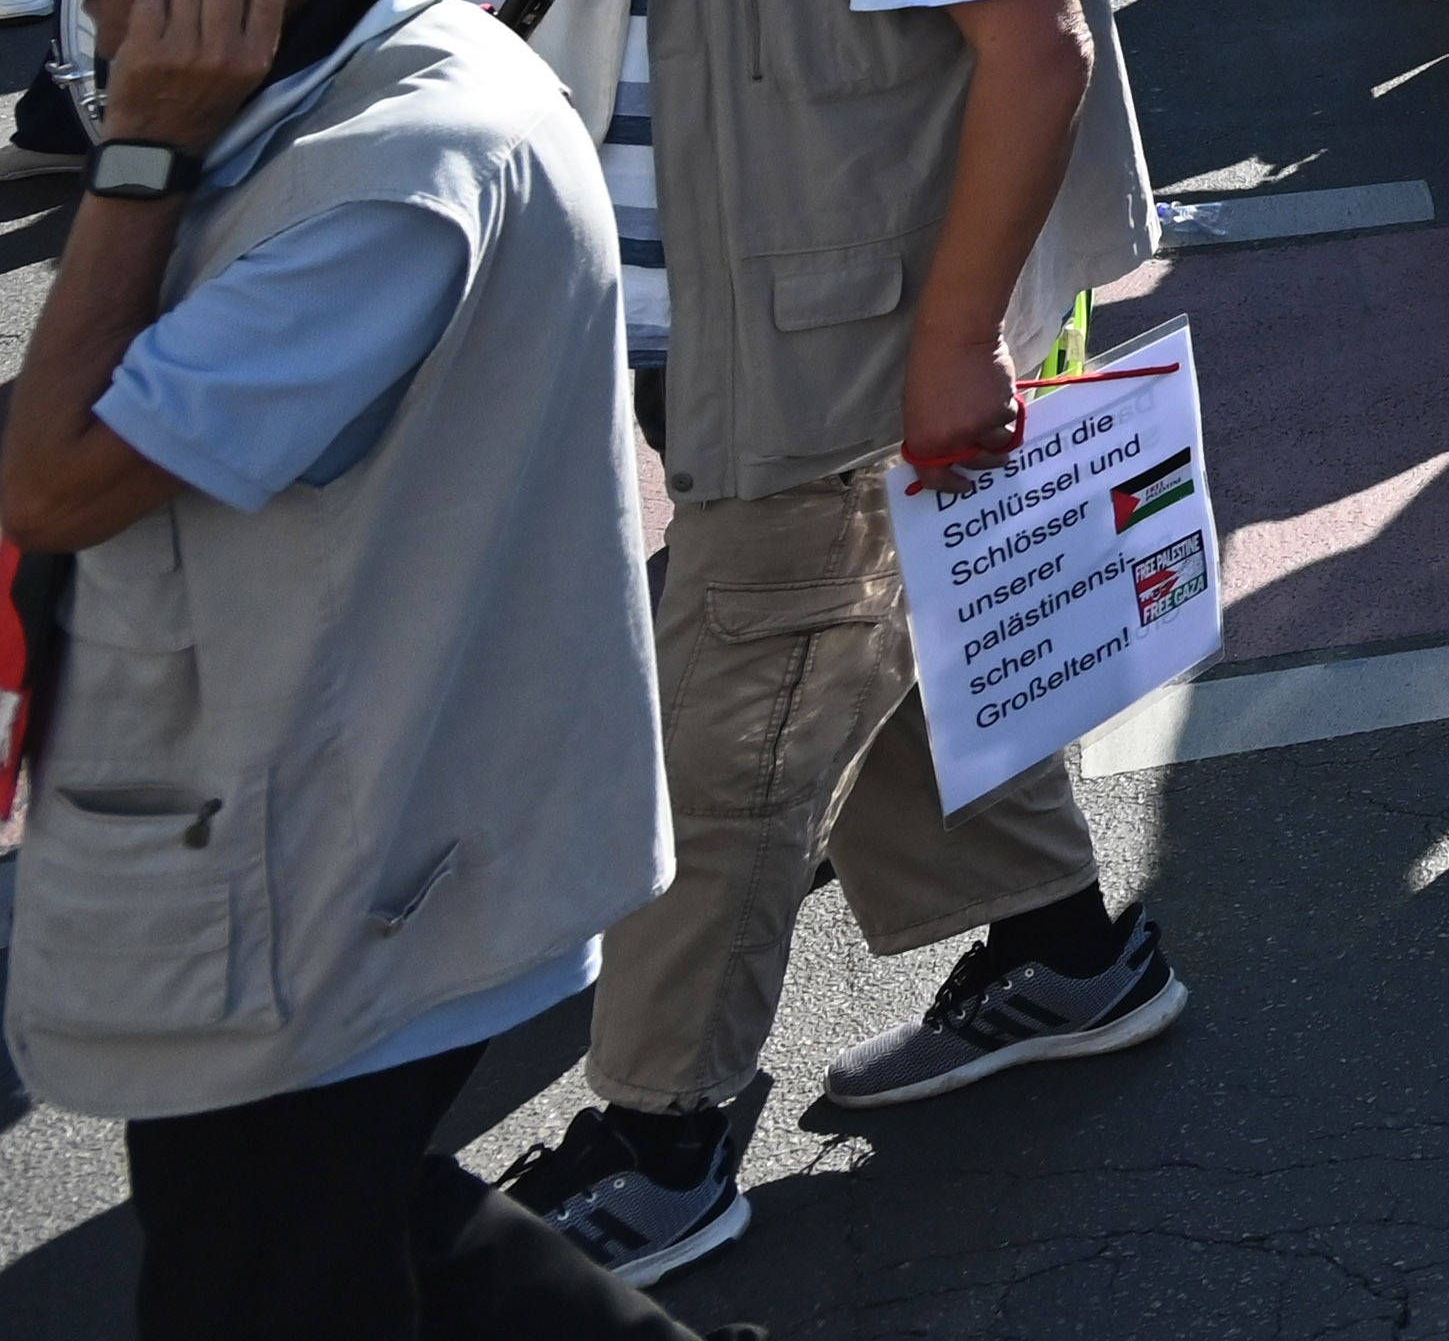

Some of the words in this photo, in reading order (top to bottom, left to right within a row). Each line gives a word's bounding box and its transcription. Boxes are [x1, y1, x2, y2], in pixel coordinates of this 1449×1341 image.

[935, 472, 996, 513] Das
[1003, 431, 1062, 479] sind
[1071, 412, 1115, 455] die
[942, 464, 1081, 549] Schlüssel
[1089, 434, 1141, 477] und
[951, 501, 1090, 587] Schlösser
[1136, 556, 1157, 583] FREE
[1156, 534, 1200, 570] PALESTINE
[958, 554, 1065, 623] unserer
[963, 552, 1135, 664] palästinensi-
[1143, 592, 1173, 625] FREE
[1173, 575, 1205, 609] GAZA
[970, 636, 1054, 696] schen
[976, 625, 1130, 729] Großeltern!
